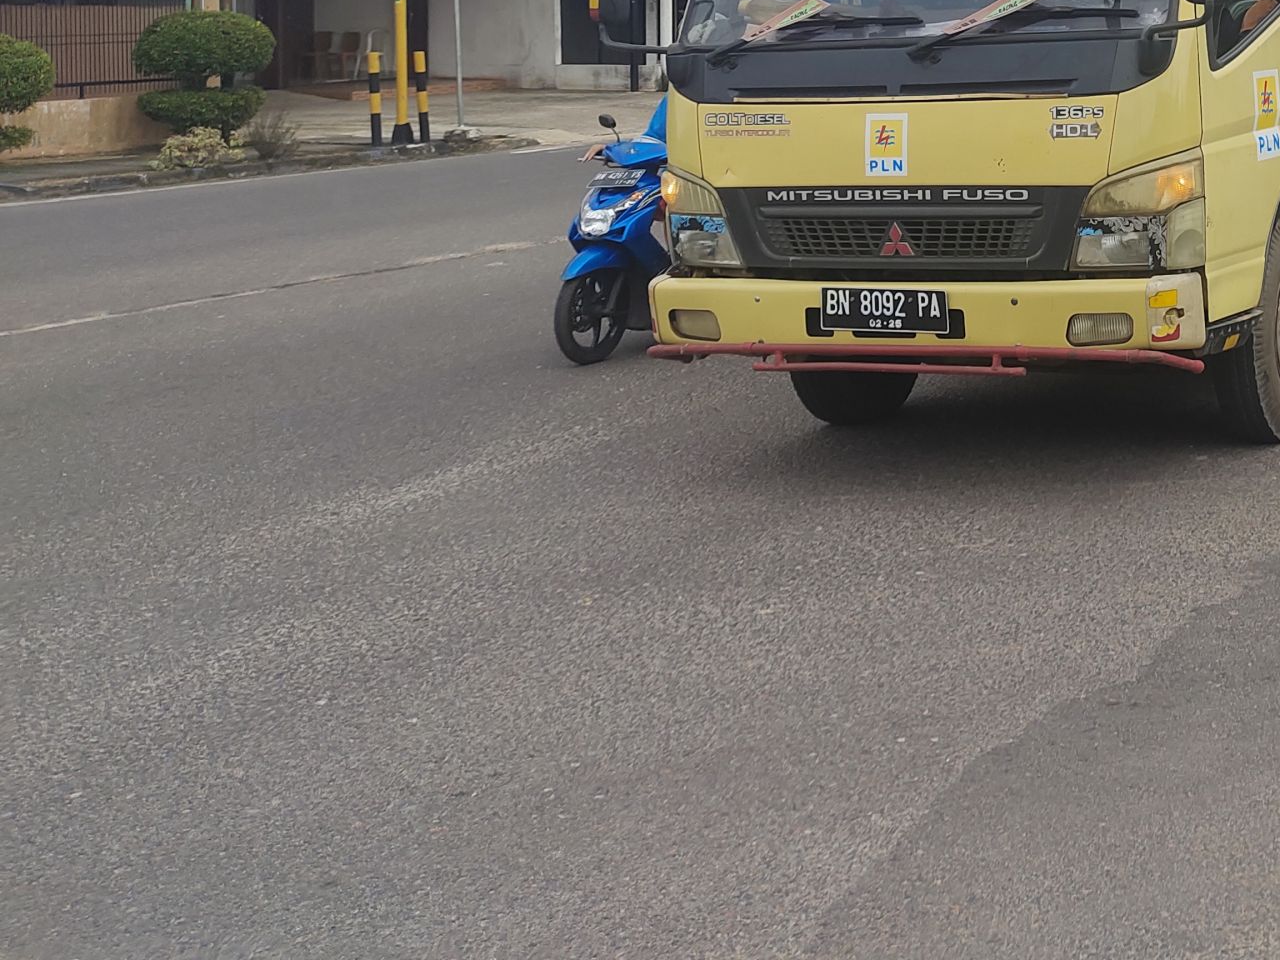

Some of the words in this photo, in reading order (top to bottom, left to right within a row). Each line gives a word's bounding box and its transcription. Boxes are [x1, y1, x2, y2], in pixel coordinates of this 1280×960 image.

[1049, 105, 1104, 119] 136PS
[704, 129, 734, 137] TURBO
[1053, 124, 1098, 137] HD-L
[1258, 133, 1280, 154] PLN
[869, 159, 903, 172] PLN
[767, 189, 931, 201] MITSUBISHI
[942, 189, 1029, 201] FUSO
[826, 289, 850, 315] BN
[860, 290, 906, 317] 8092
[917, 292, 941, 318] PA
